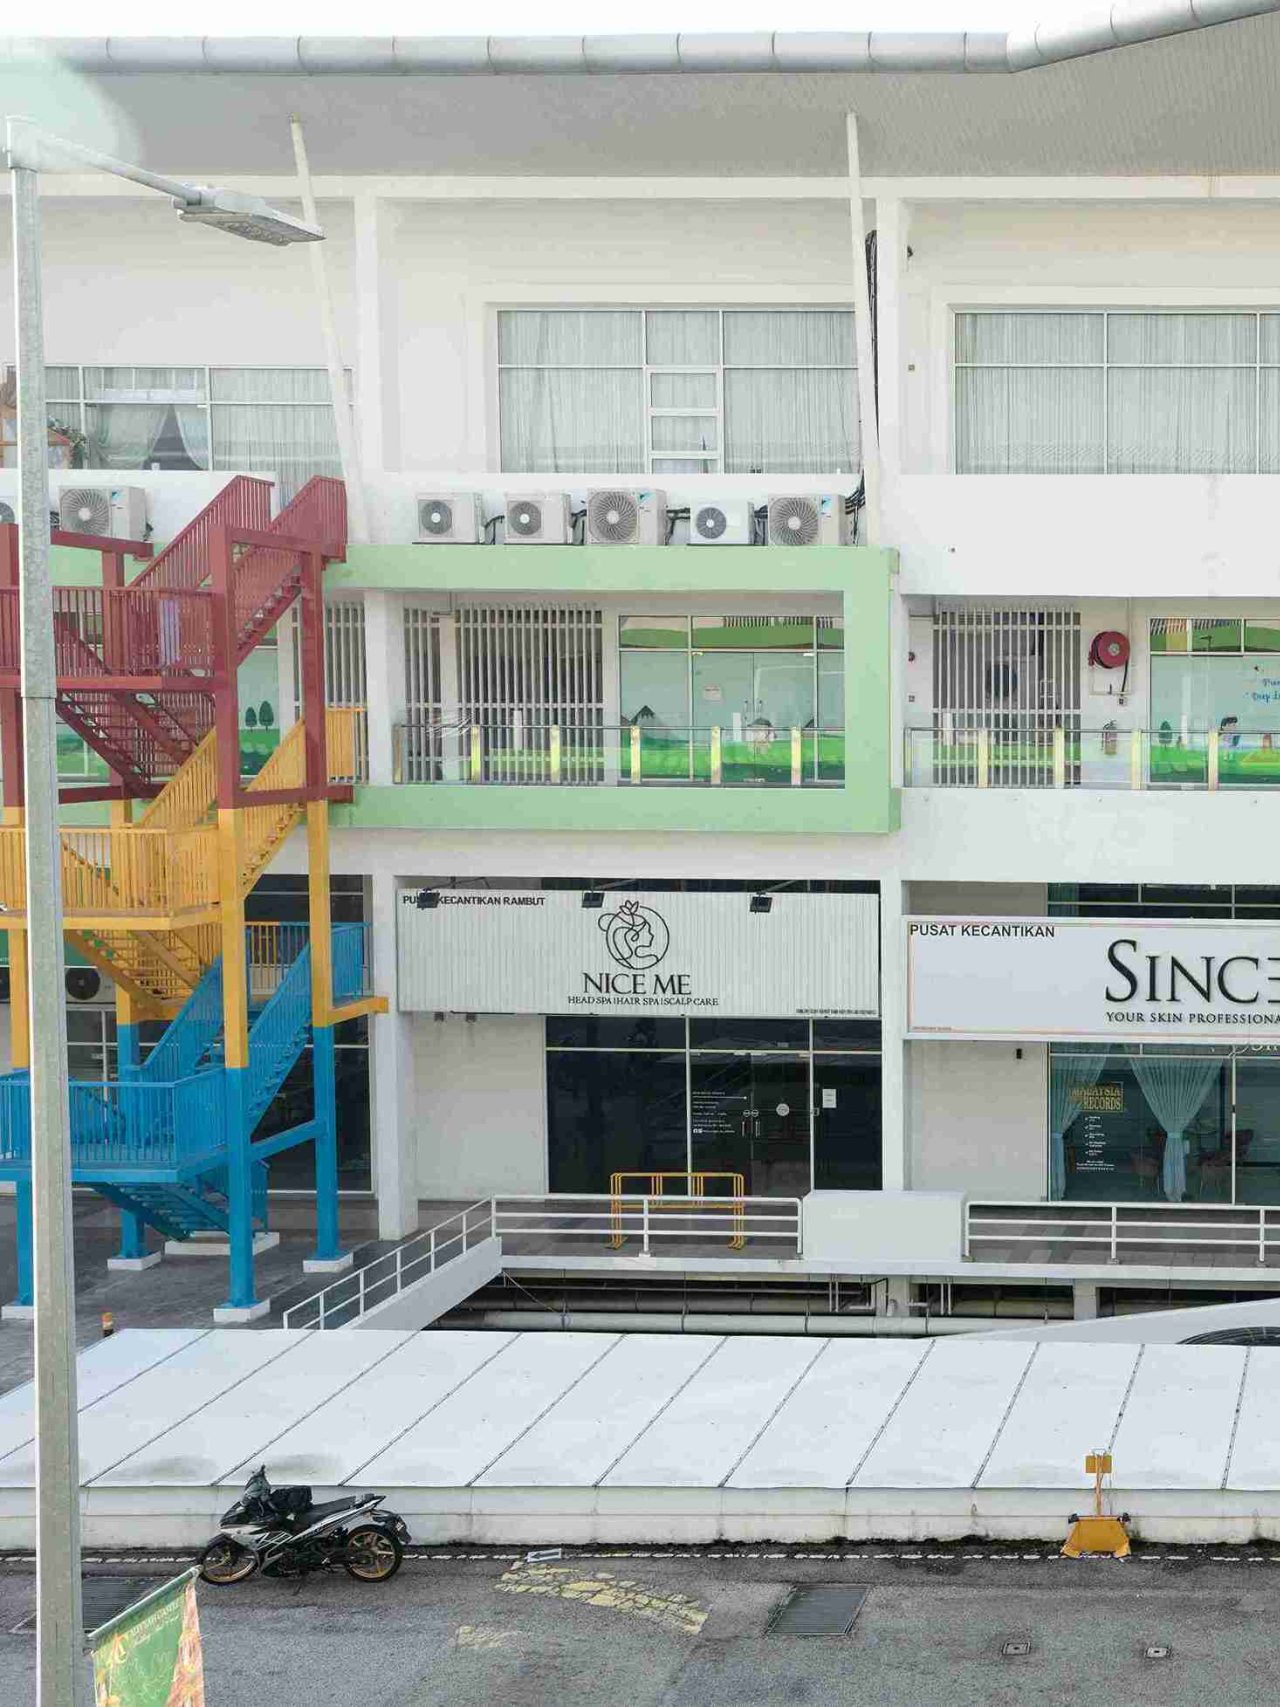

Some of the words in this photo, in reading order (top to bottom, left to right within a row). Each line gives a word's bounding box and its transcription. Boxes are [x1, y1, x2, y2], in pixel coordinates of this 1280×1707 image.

[438, 896, 501, 905] KECANTIKAN
[503, 897, 545, 906] RAMBUT
[910, 924, 956, 936] PUSAT
[961, 925, 1055, 937] KECANTIKAN
[583, 972, 647, 994] NICE
[653, 974, 692, 995] ME
[568, 996, 595, 1004] HEAD
[596, 997, 612, 1005] SPA
[693, 998, 719, 1006] CARE
[1106, 1011, 1145, 1022] YOUR
[1150, 1012, 1182, 1023] SKIN
